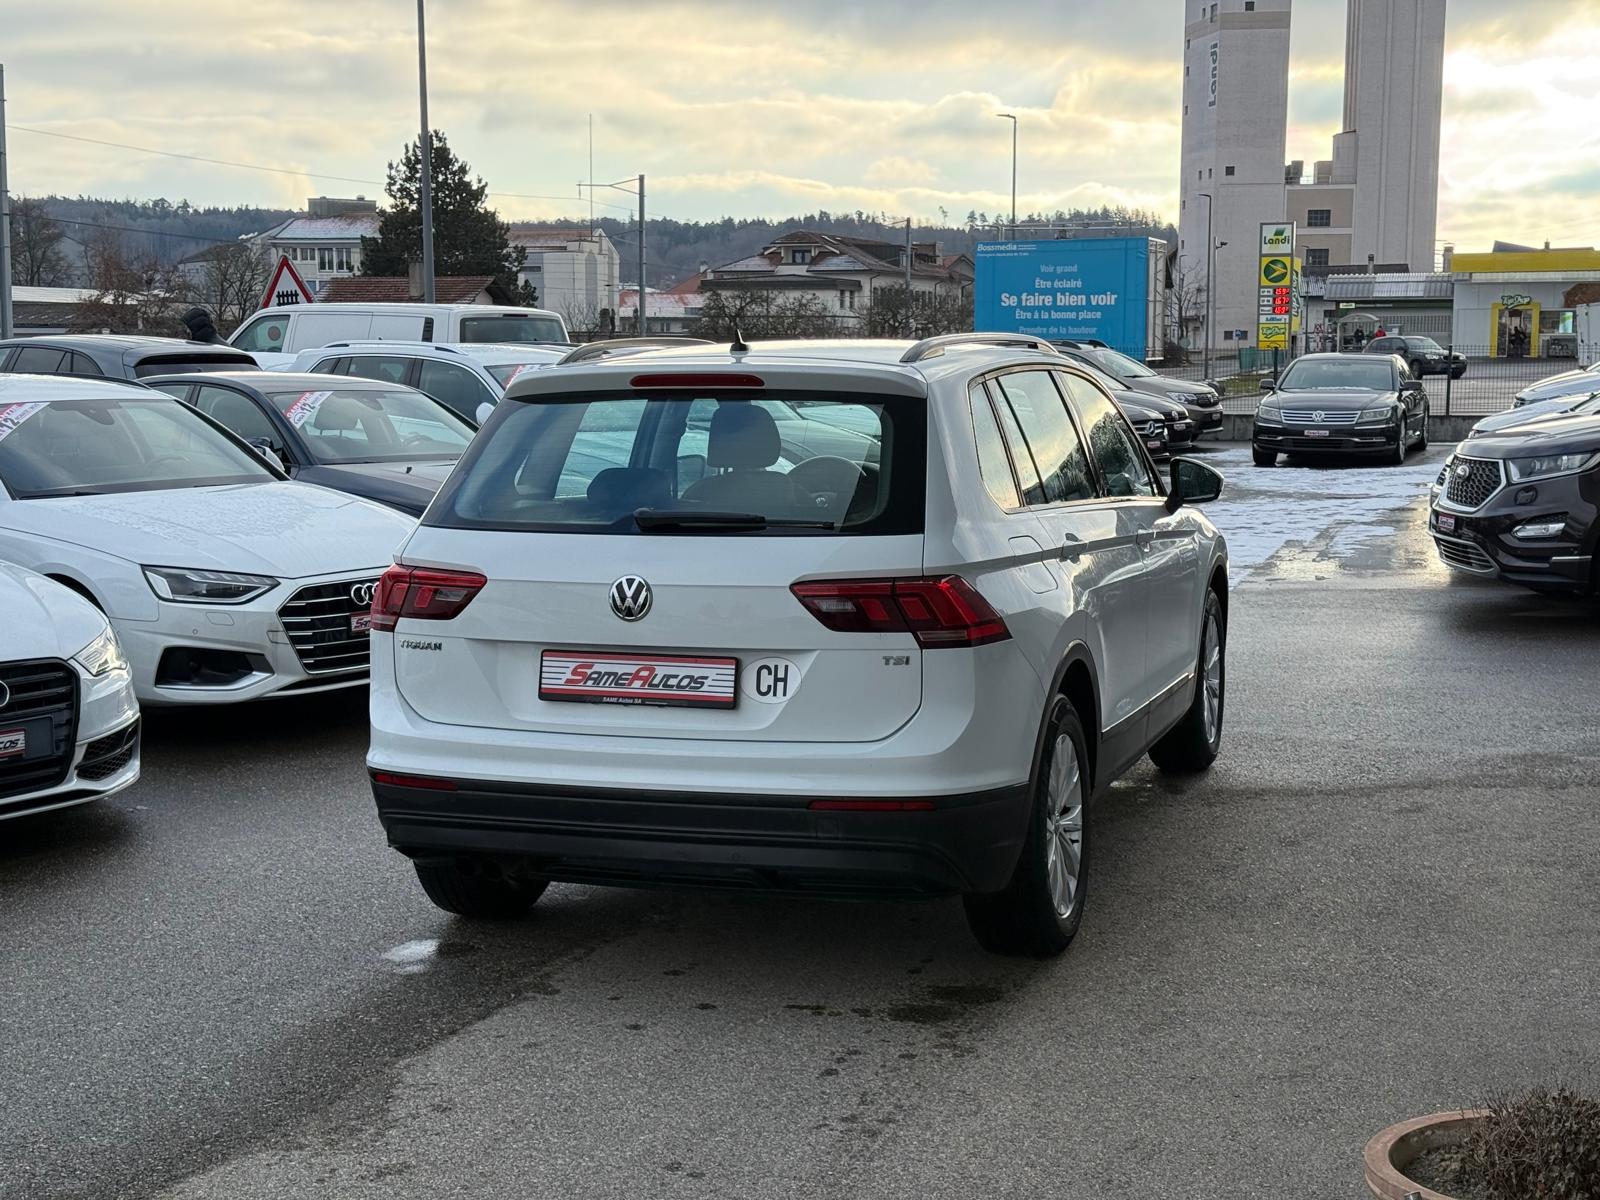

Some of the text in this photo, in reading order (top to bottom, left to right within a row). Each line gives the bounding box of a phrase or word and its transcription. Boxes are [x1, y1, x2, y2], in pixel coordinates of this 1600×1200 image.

[1208, 42, 1218, 107] Landi
[1263, 236, 1290, 245] Landi
[977, 243, 1017, 251] Bossmedia
[1040, 264, 1078, 274] Voir grand
[1035, 278, 1082, 288] Être éclairé
[1001, 291, 1118, 307] Se faire bien voir
[1015, 310, 1032, 320] Être
[1041, 310, 1049, 319] la
[1051, 310, 1077, 319] bonne
[1078, 310, 1102, 320] place
[1049, 326, 1058, 334] de
[1059, 326, 1067, 334] la
[401, 640, 442, 651] TIGUAN
[882, 656, 910, 666] TSI
[756, 664, 789, 697] CH
